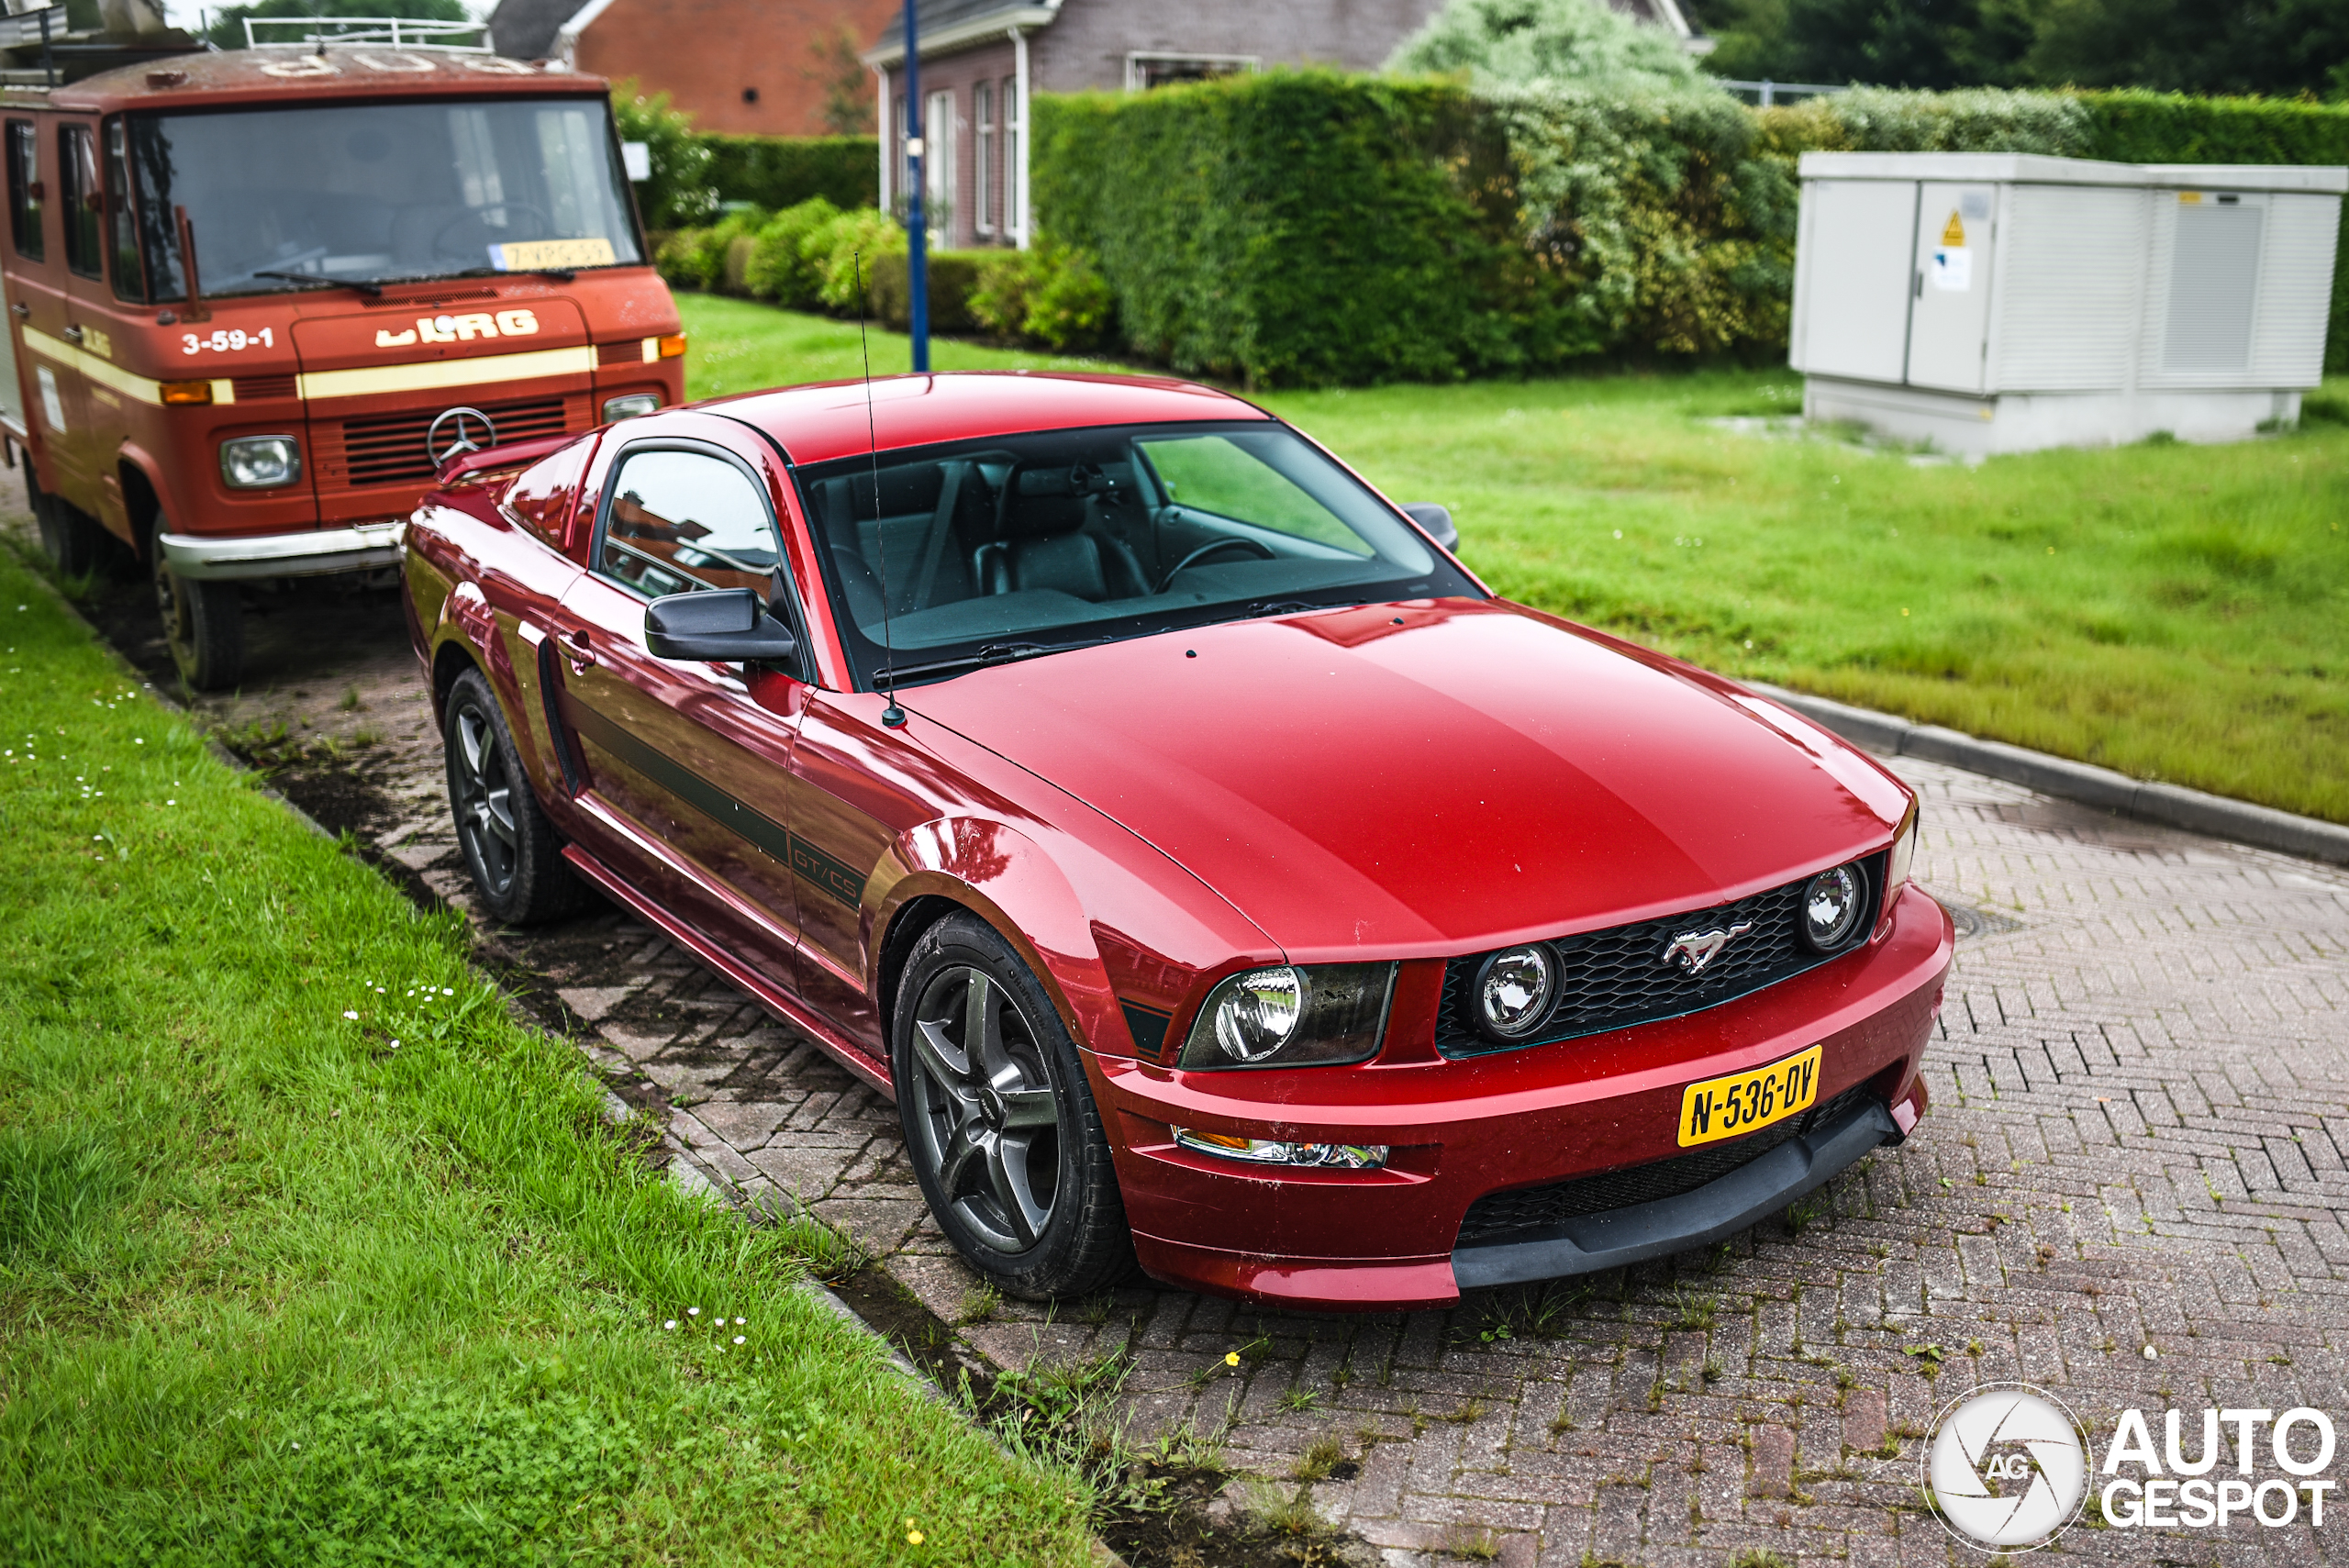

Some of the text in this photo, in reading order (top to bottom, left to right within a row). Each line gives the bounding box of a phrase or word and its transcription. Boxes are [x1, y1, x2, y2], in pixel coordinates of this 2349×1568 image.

[182, 327, 274, 356] 3-59-1
[795, 849, 857, 898] GT/CS
[1690, 1056, 1815, 1137] N-536-DV
